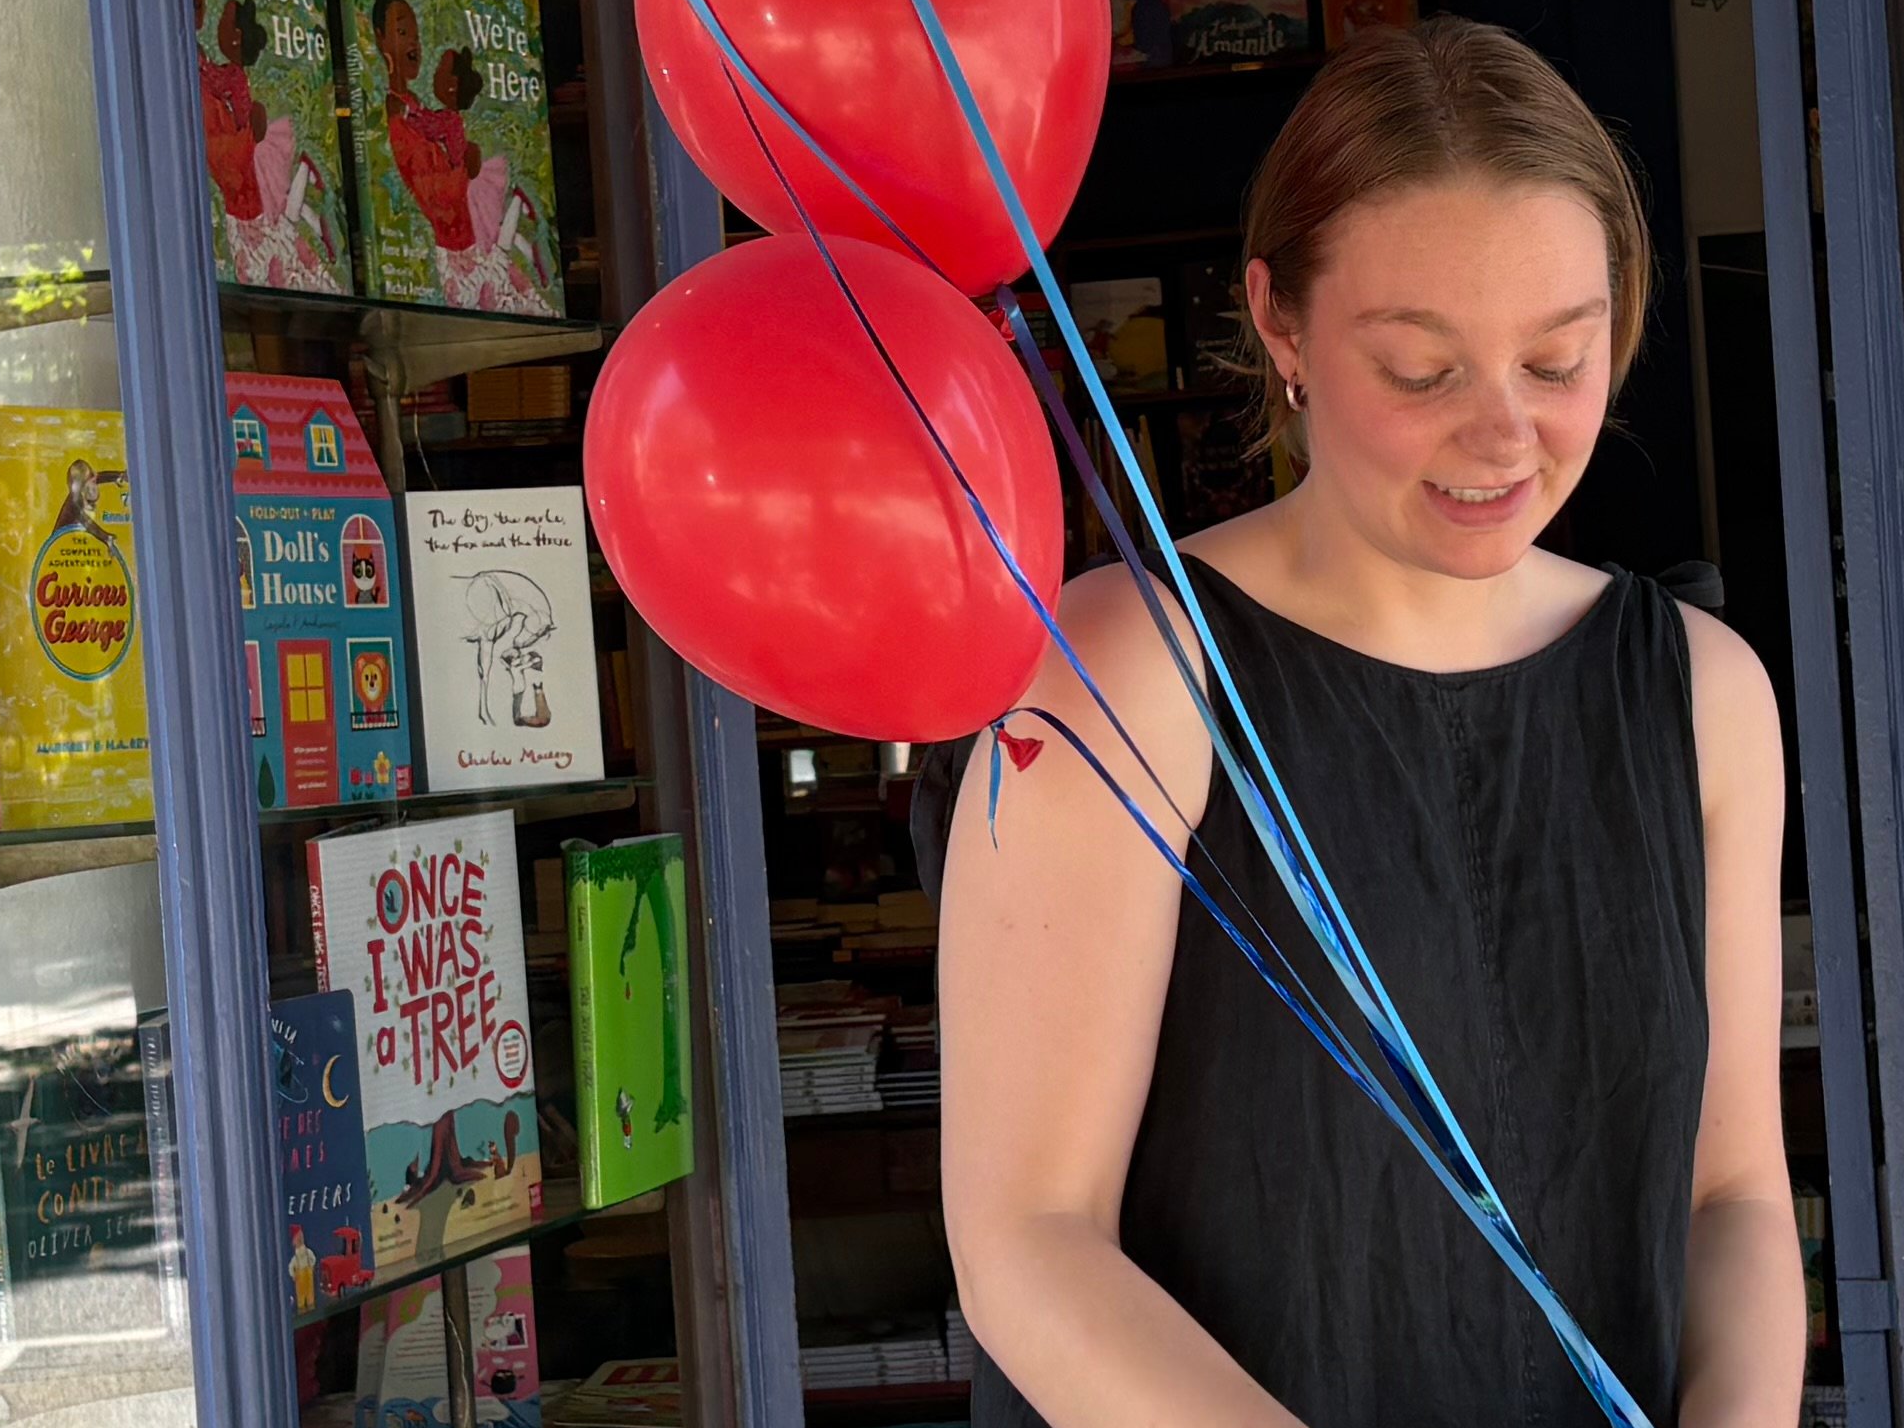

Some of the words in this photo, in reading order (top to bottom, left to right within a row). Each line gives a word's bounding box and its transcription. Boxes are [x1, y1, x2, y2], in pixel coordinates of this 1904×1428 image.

[272, 15, 325, 63] Here
[464, 9, 529, 57] We're
[488, 62, 541, 103] Here
[311, 508, 336, 520] PLAY
[263, 529, 330, 564] Doll's
[36, 571, 128, 609] Curious
[261, 572, 337, 606] House
[43, 609, 127, 652] George
[375, 852, 485, 934] ONCE
[367, 939, 388, 1014] I
[398, 919, 483, 997] WAS
[376, 1026, 396, 1067] a
[400, 971, 497, 1086] TREE
[288, 1182, 353, 1215] EFFERS
